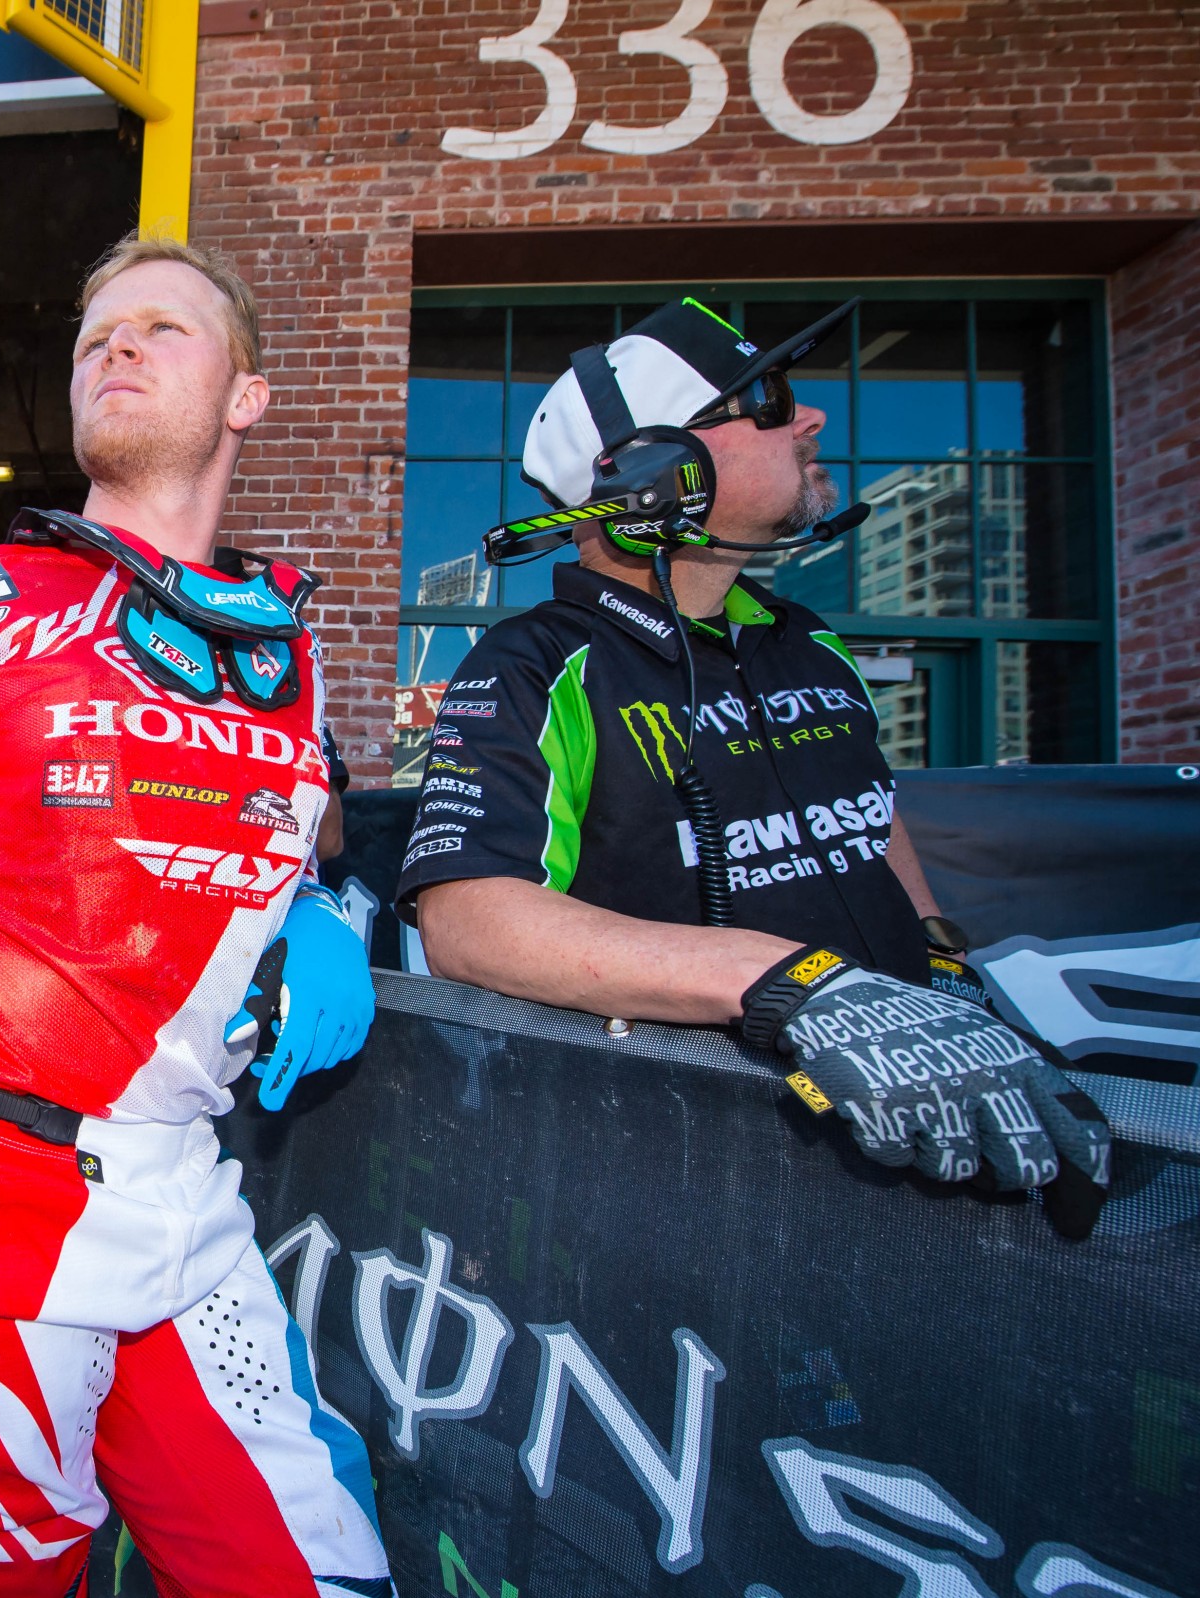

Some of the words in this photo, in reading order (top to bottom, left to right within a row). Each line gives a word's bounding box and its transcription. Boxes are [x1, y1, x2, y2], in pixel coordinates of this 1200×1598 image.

[441, 0, 914, 160] 336
[612, 520, 665, 535] KX
[684, 532, 700, 541] DINO
[599, 590, 675, 639] Kawasaki
[44, 699, 330, 783] HONDA
[726, 722, 852, 755] ENERGY
[129, 779, 230, 804] DUNLOP
[238, 812, 299, 835] RENTHAL
[425, 802, 485, 817] COMETIC
[728, 848, 849, 892] Racing
[843, 835, 891, 861] Te
[160, 880, 266, 904] RACING
[785, 989, 960, 1052] Mechanix
[840, 1024, 1044, 1091] Mechanix
